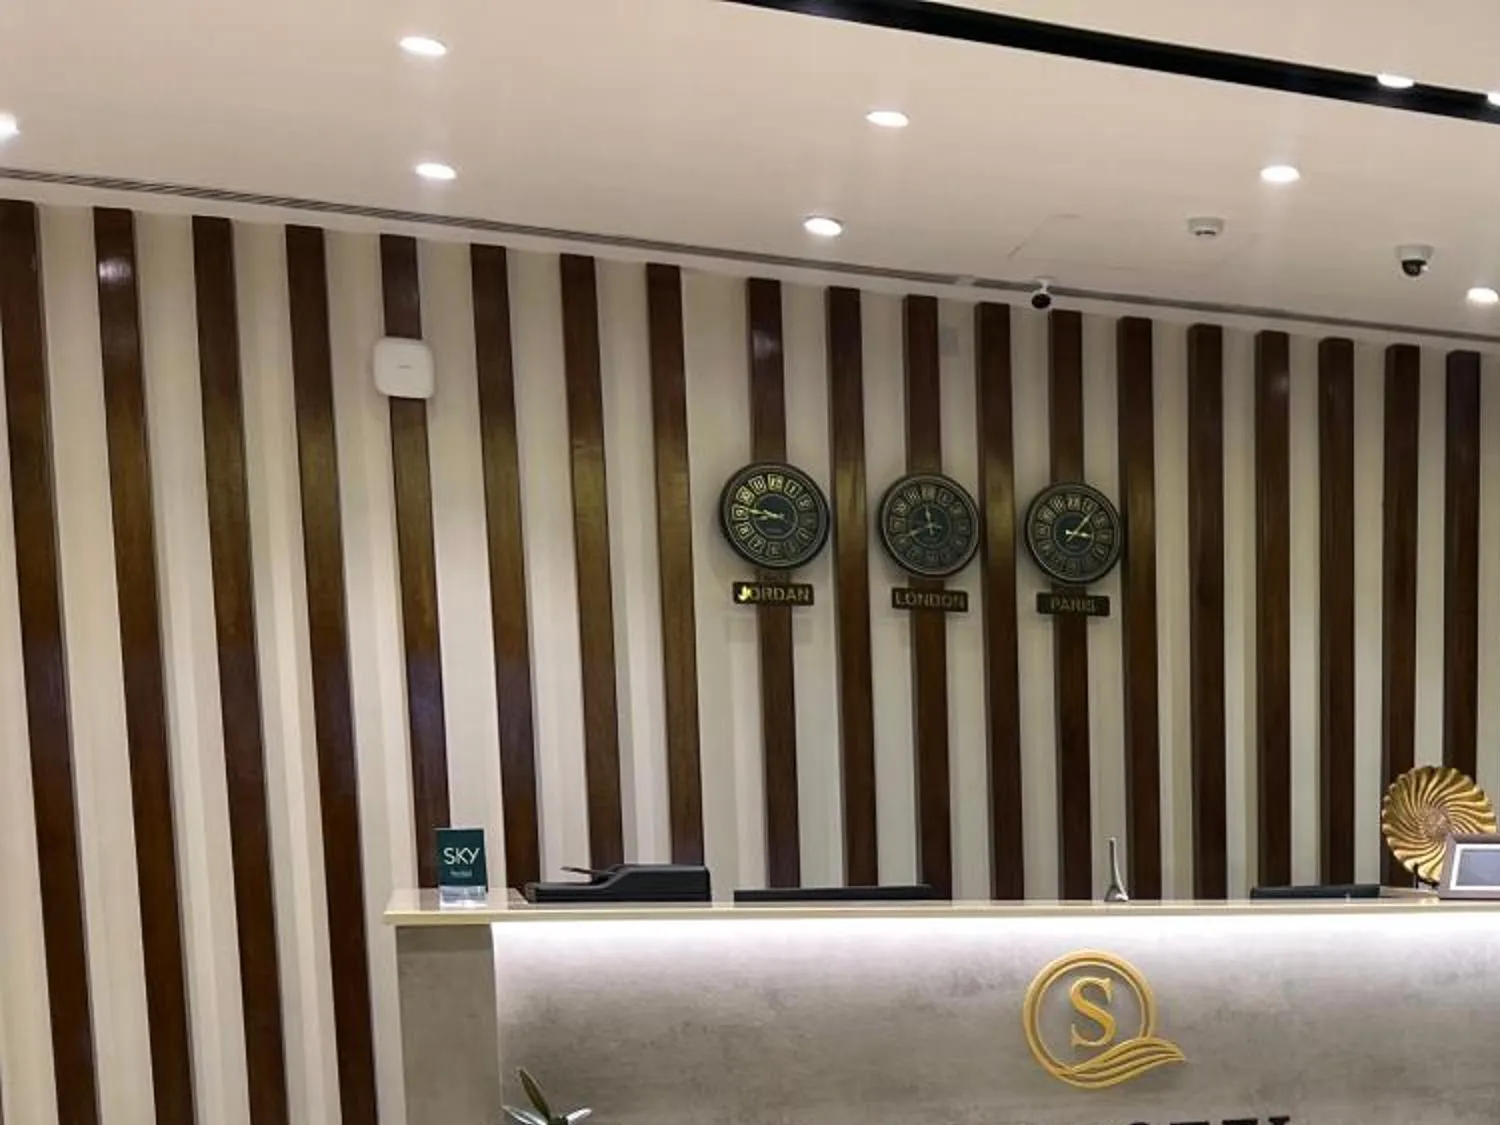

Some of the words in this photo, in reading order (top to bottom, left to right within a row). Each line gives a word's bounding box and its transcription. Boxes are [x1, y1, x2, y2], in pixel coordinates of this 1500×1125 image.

[738, 585, 809, 602] JORDAN
[894, 591, 966, 609] LONDON
[443, 847, 480, 865] SKY
[1069, 975, 1116, 1048] S
